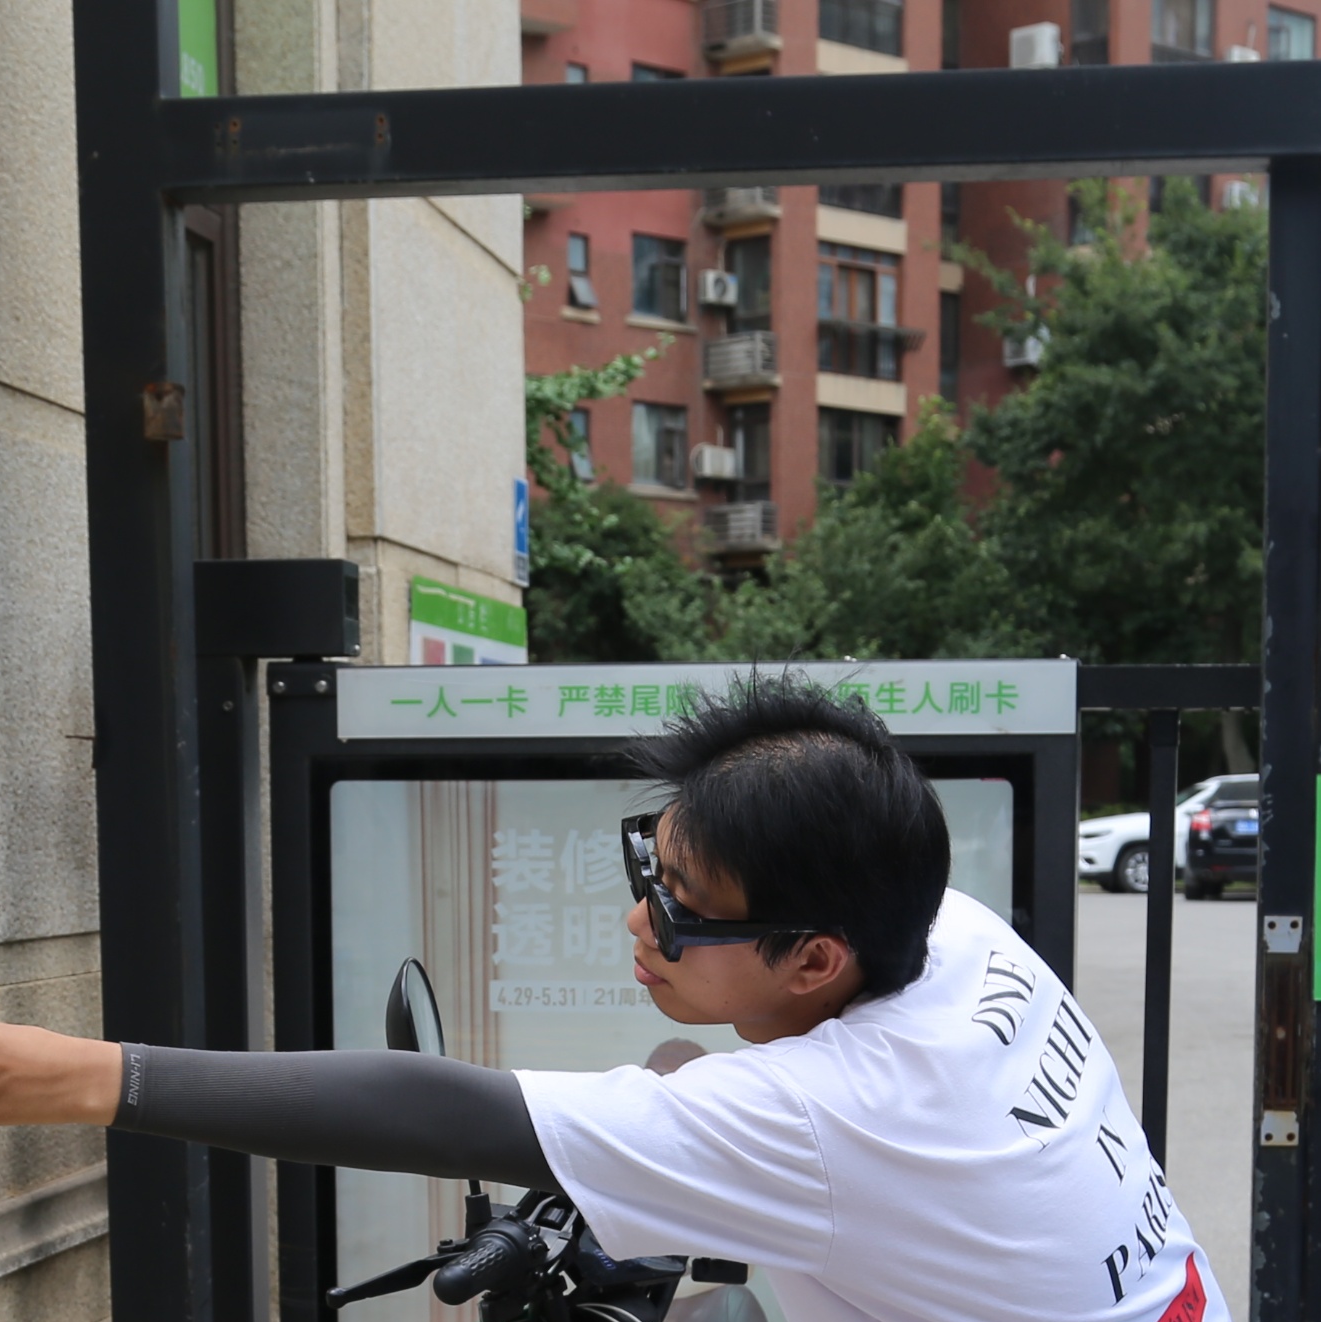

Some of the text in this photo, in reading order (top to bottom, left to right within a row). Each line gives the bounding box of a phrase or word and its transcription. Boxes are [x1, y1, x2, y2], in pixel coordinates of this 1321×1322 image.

[390, 685, 529, 718] 一人一卡
[497, 986, 577, 1007] 4.29-5.31
[972, 950, 1037, 1047] ONE
[1005, 990, 1093, 1154] NIGHT
[1095, 1105, 1129, 1187] IN
